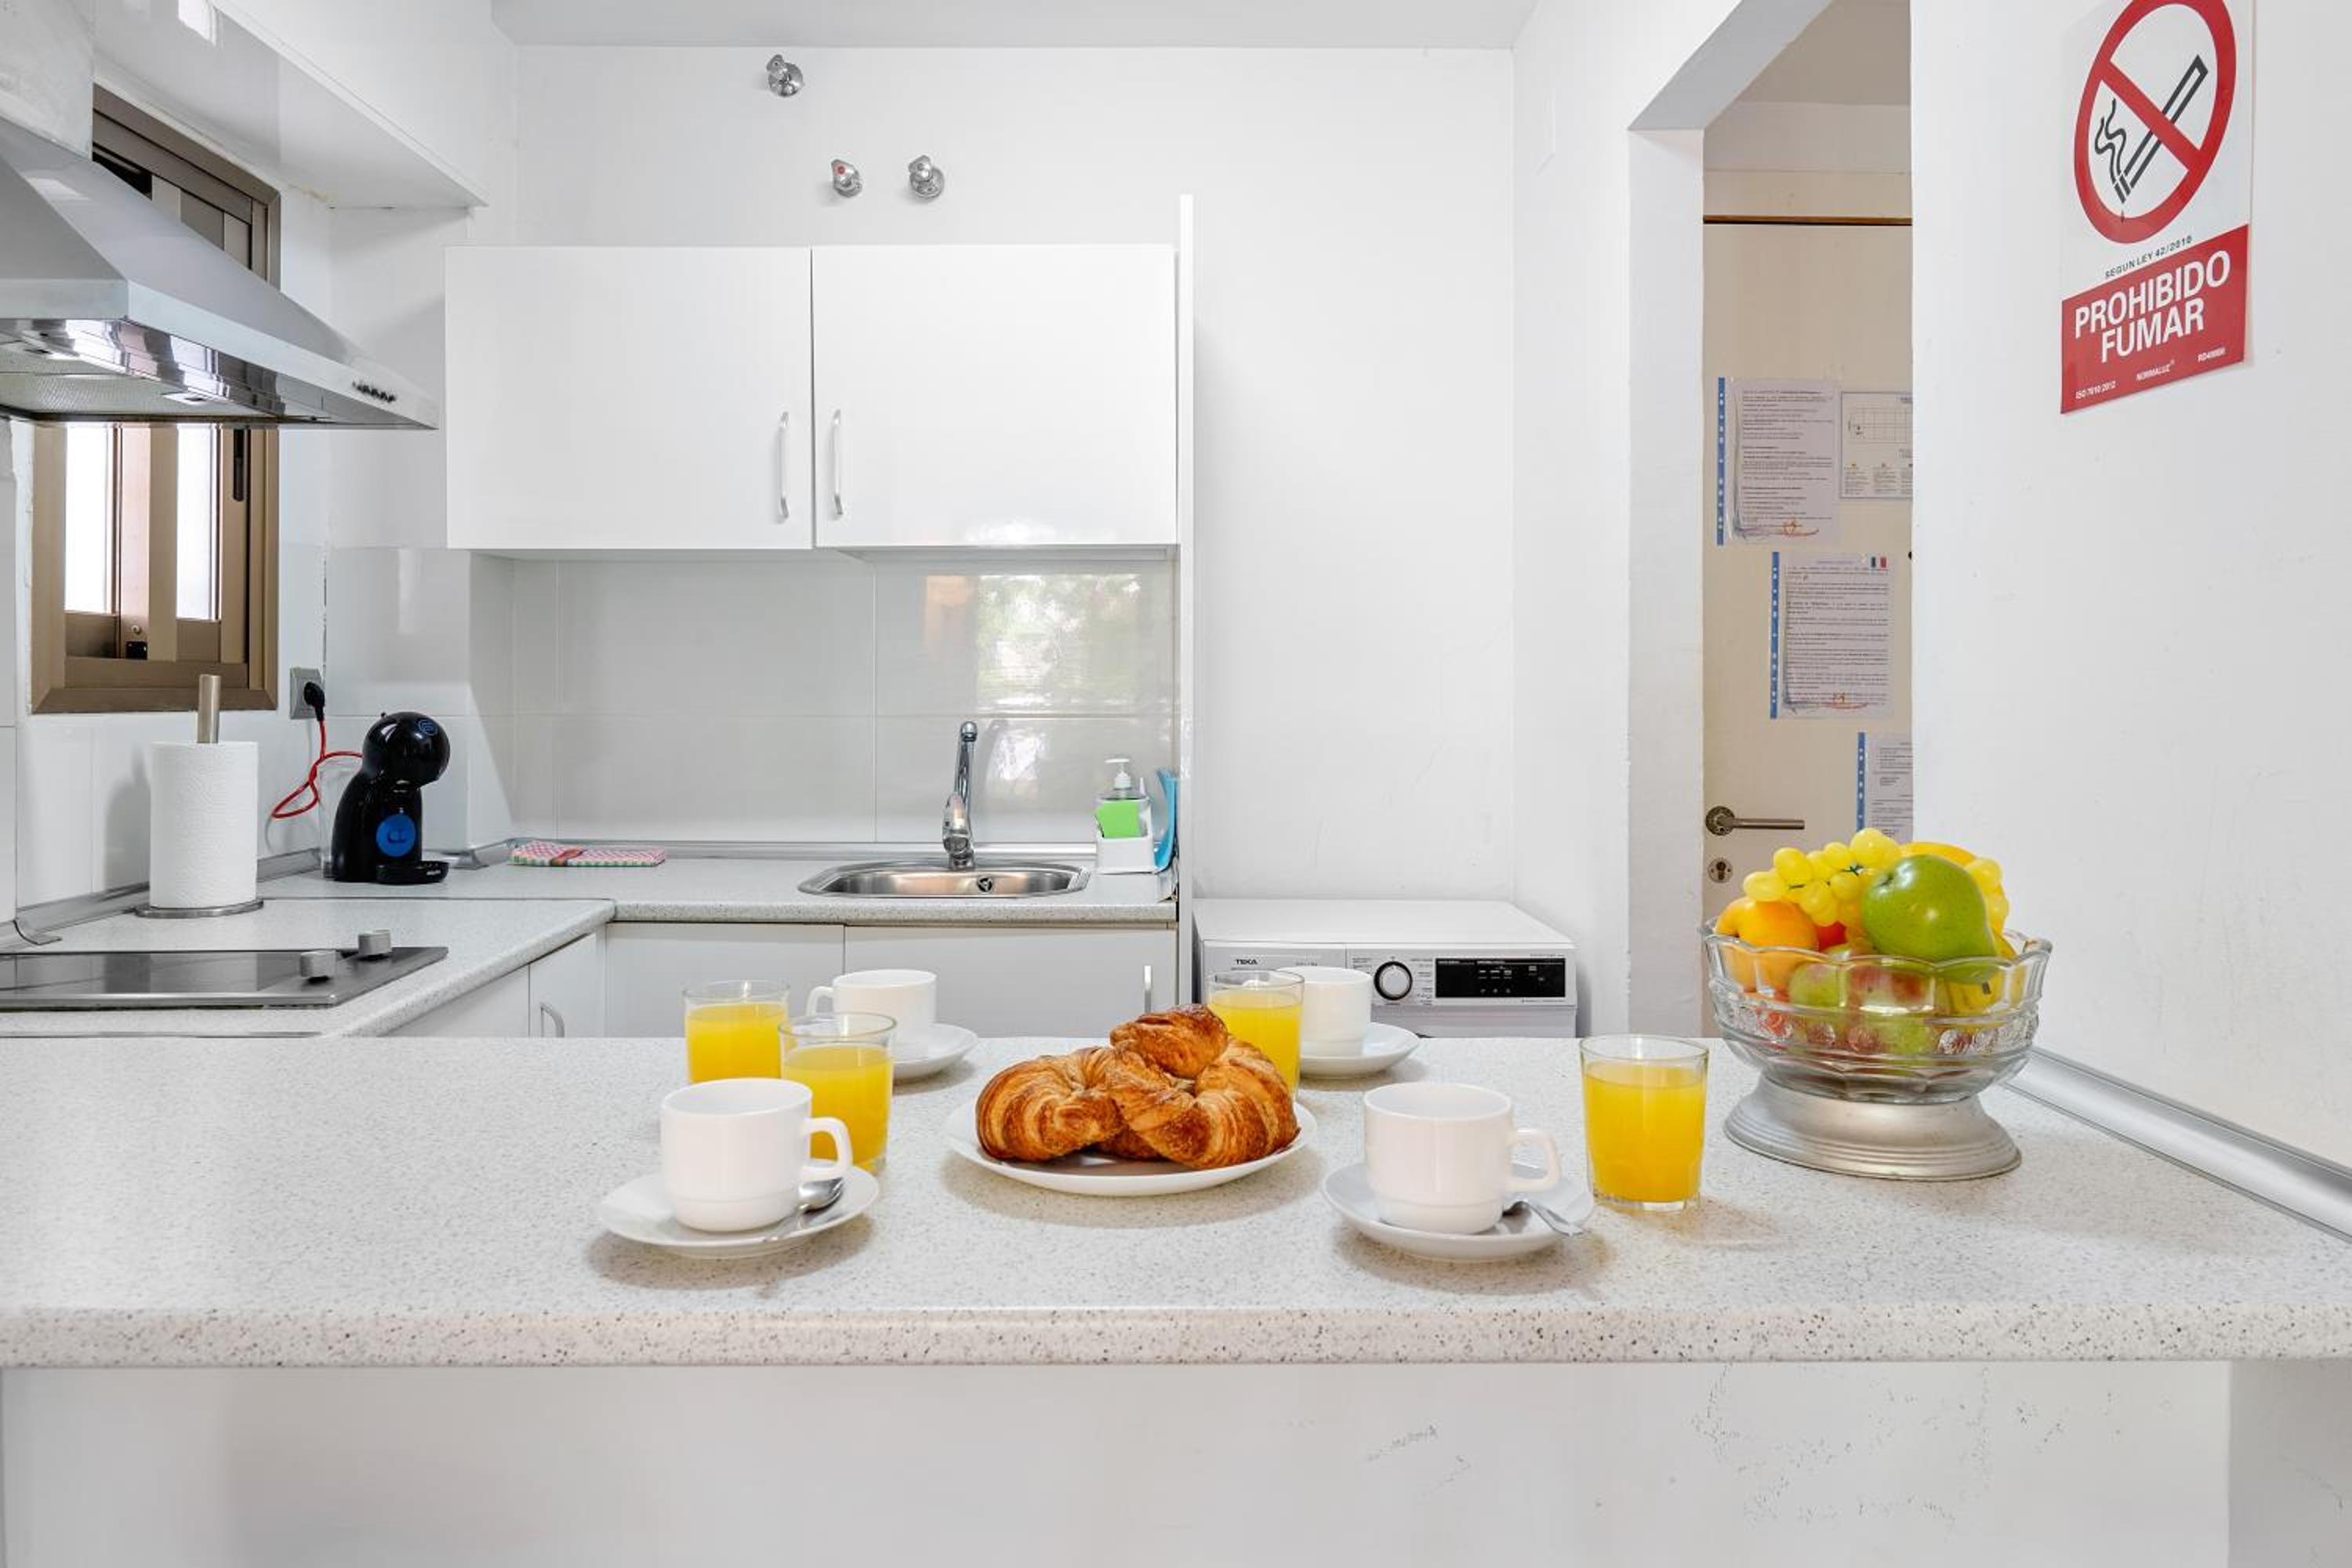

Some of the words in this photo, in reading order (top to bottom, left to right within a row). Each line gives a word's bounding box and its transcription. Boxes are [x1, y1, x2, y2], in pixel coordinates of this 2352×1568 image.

[2136, 250, 2153, 265] LEY
[2154, 235, 2193, 256] 42/2010
[2074, 249, 2231, 339] PROHIBIDO
[2101, 297, 2205, 363] FUMAR
